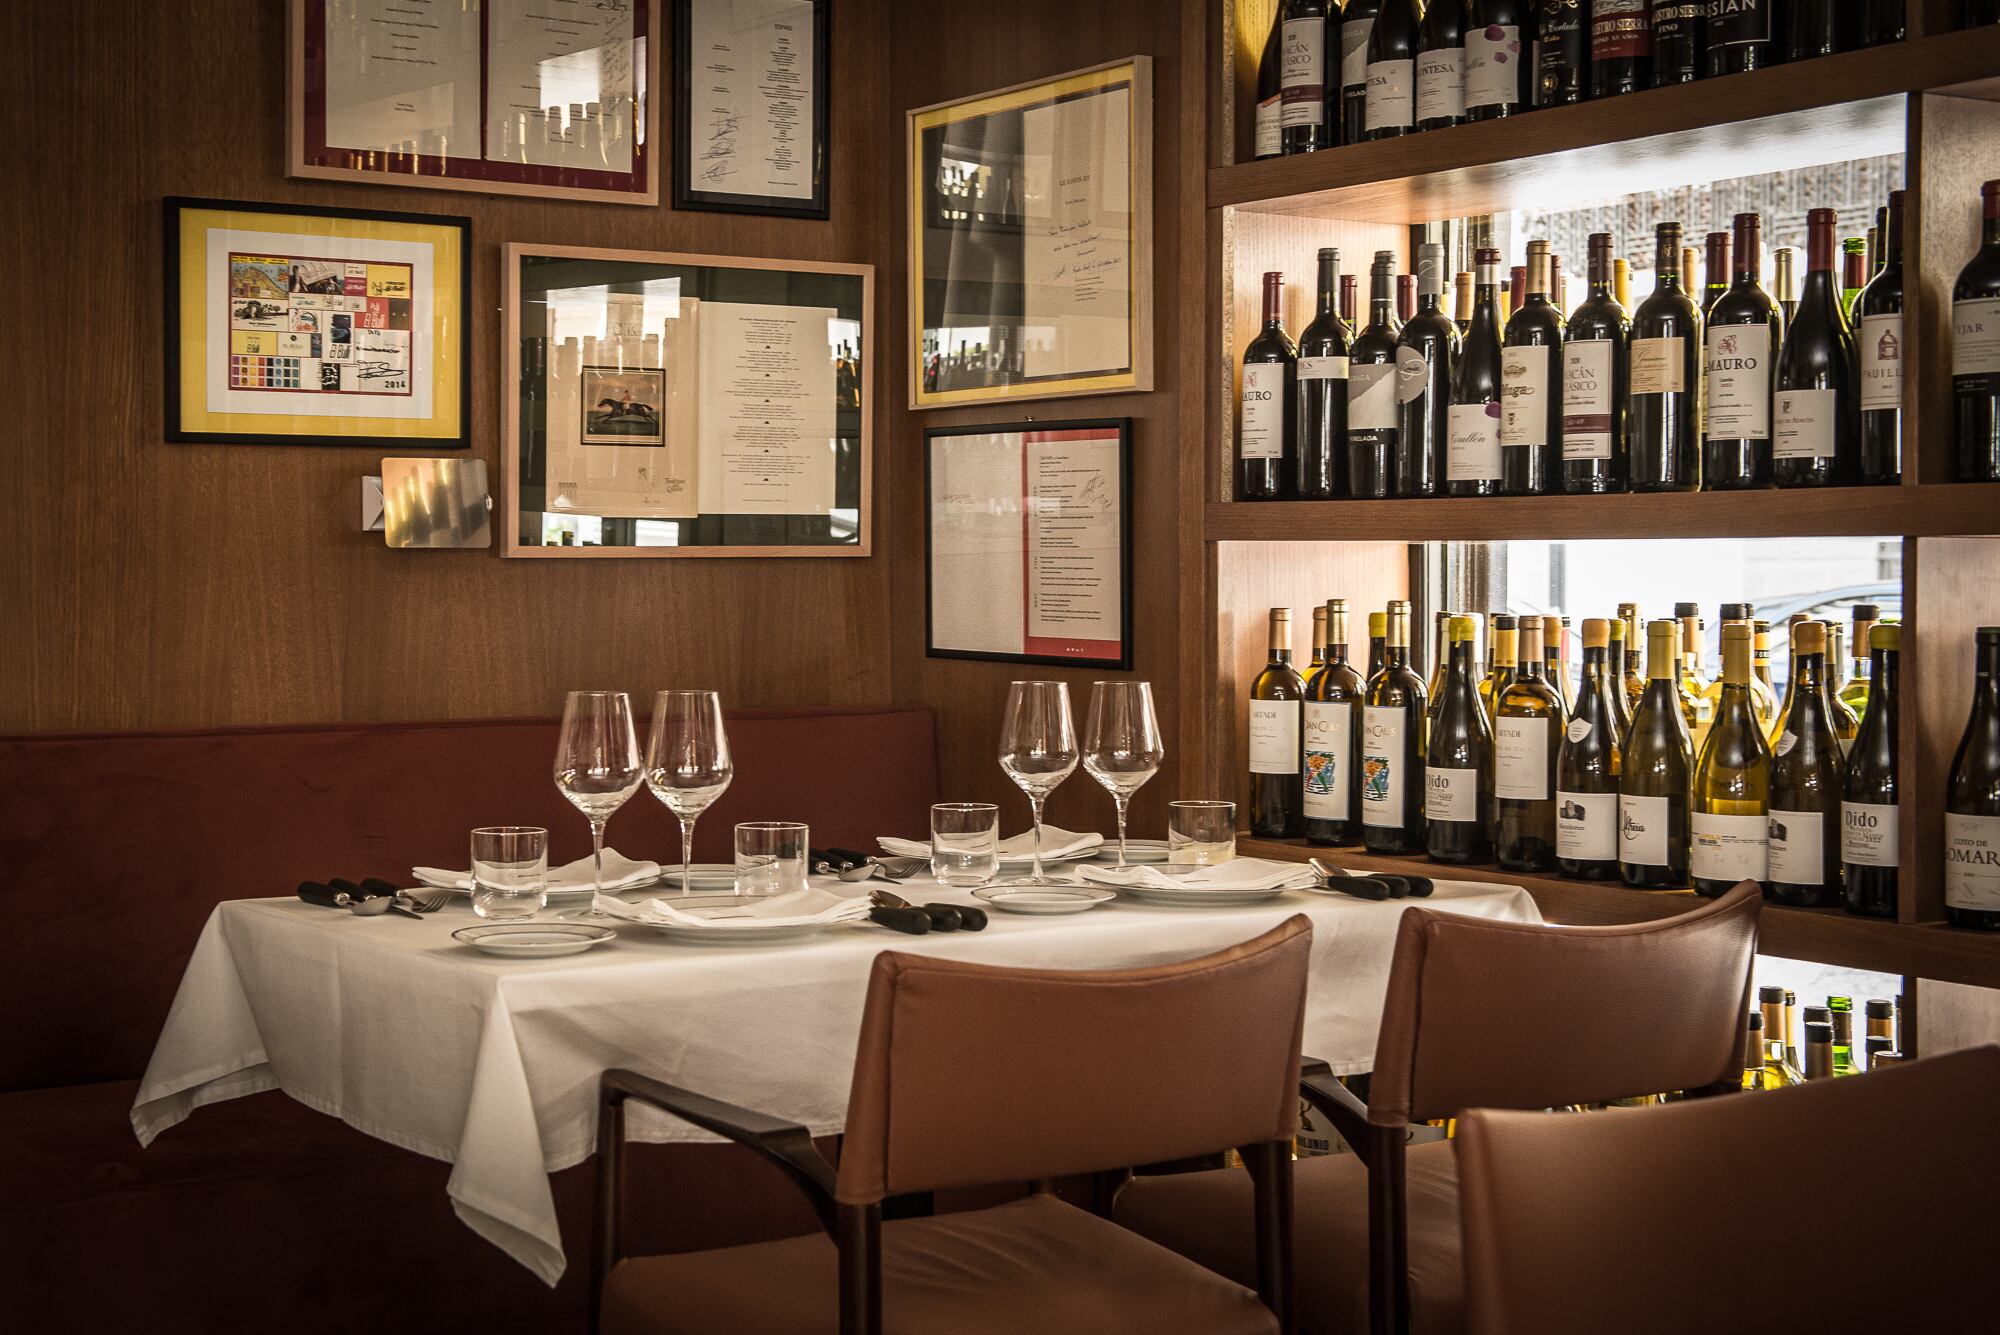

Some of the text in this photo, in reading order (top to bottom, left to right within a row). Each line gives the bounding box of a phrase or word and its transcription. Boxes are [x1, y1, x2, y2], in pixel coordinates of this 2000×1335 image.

[1679, 4, 1705, 18] SIERR
[1707, 358, 1756, 372] MAURO
[1845, 810, 1878, 828] Dido
[1953, 838, 1988, 848] COTO DE
